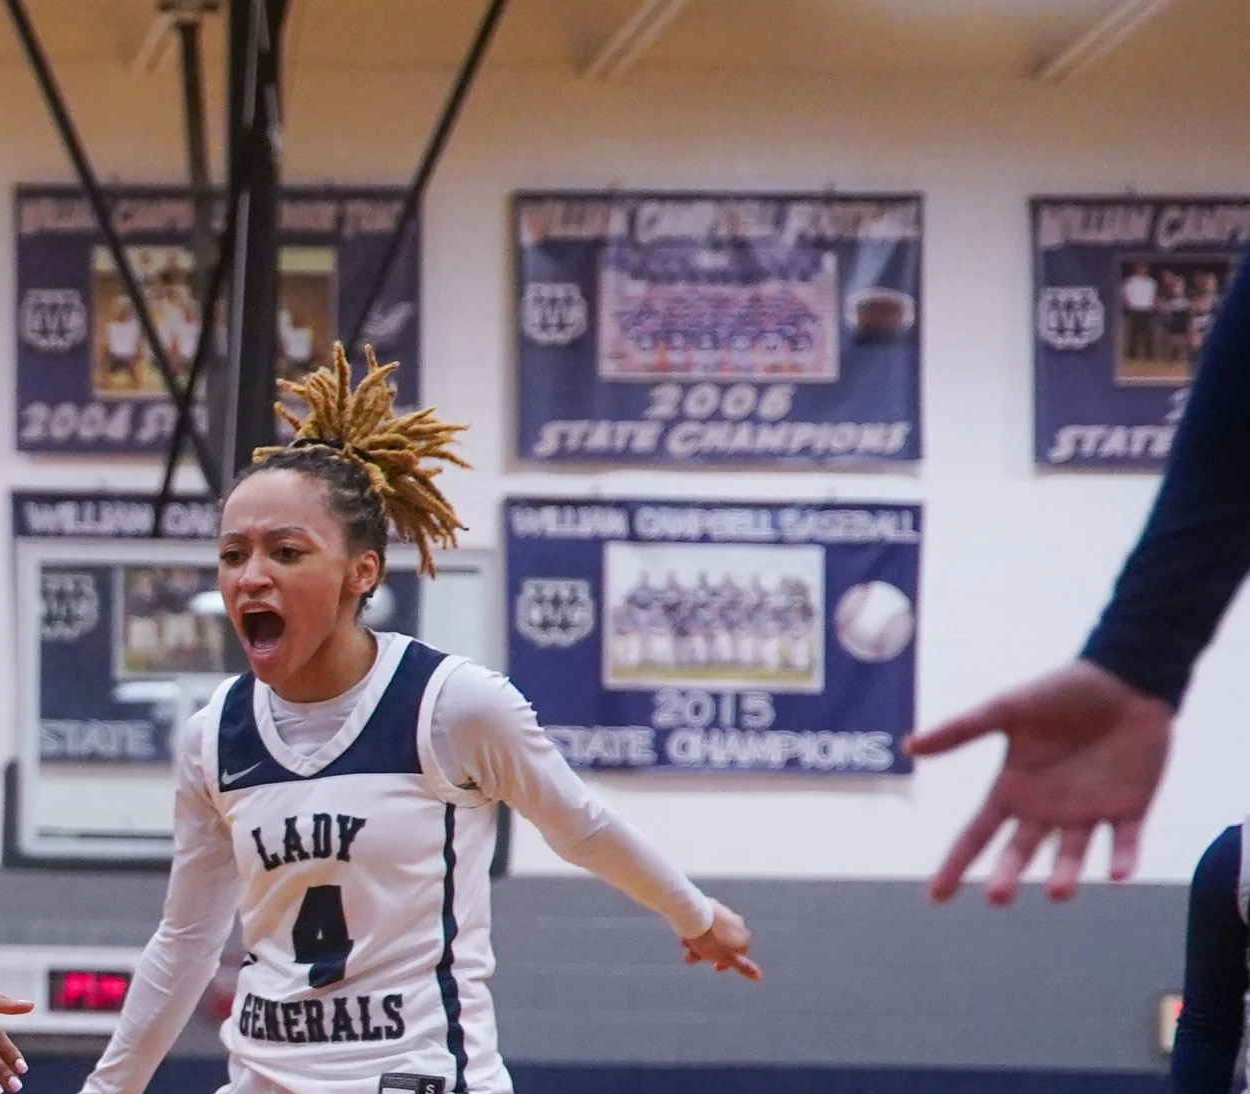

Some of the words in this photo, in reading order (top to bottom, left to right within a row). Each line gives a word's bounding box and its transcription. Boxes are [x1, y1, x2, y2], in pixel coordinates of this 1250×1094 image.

[533, 420, 663, 457] STATE
[667, 420, 911, 457] CHAMPIONS
[652, 689, 777, 730] 2015
[665, 728, 895, 772] CHAMPIONS
[251, 813, 366, 871] LADY
[291, 884, 354, 988] 4
[239, 992, 406, 1043] GENERALS
